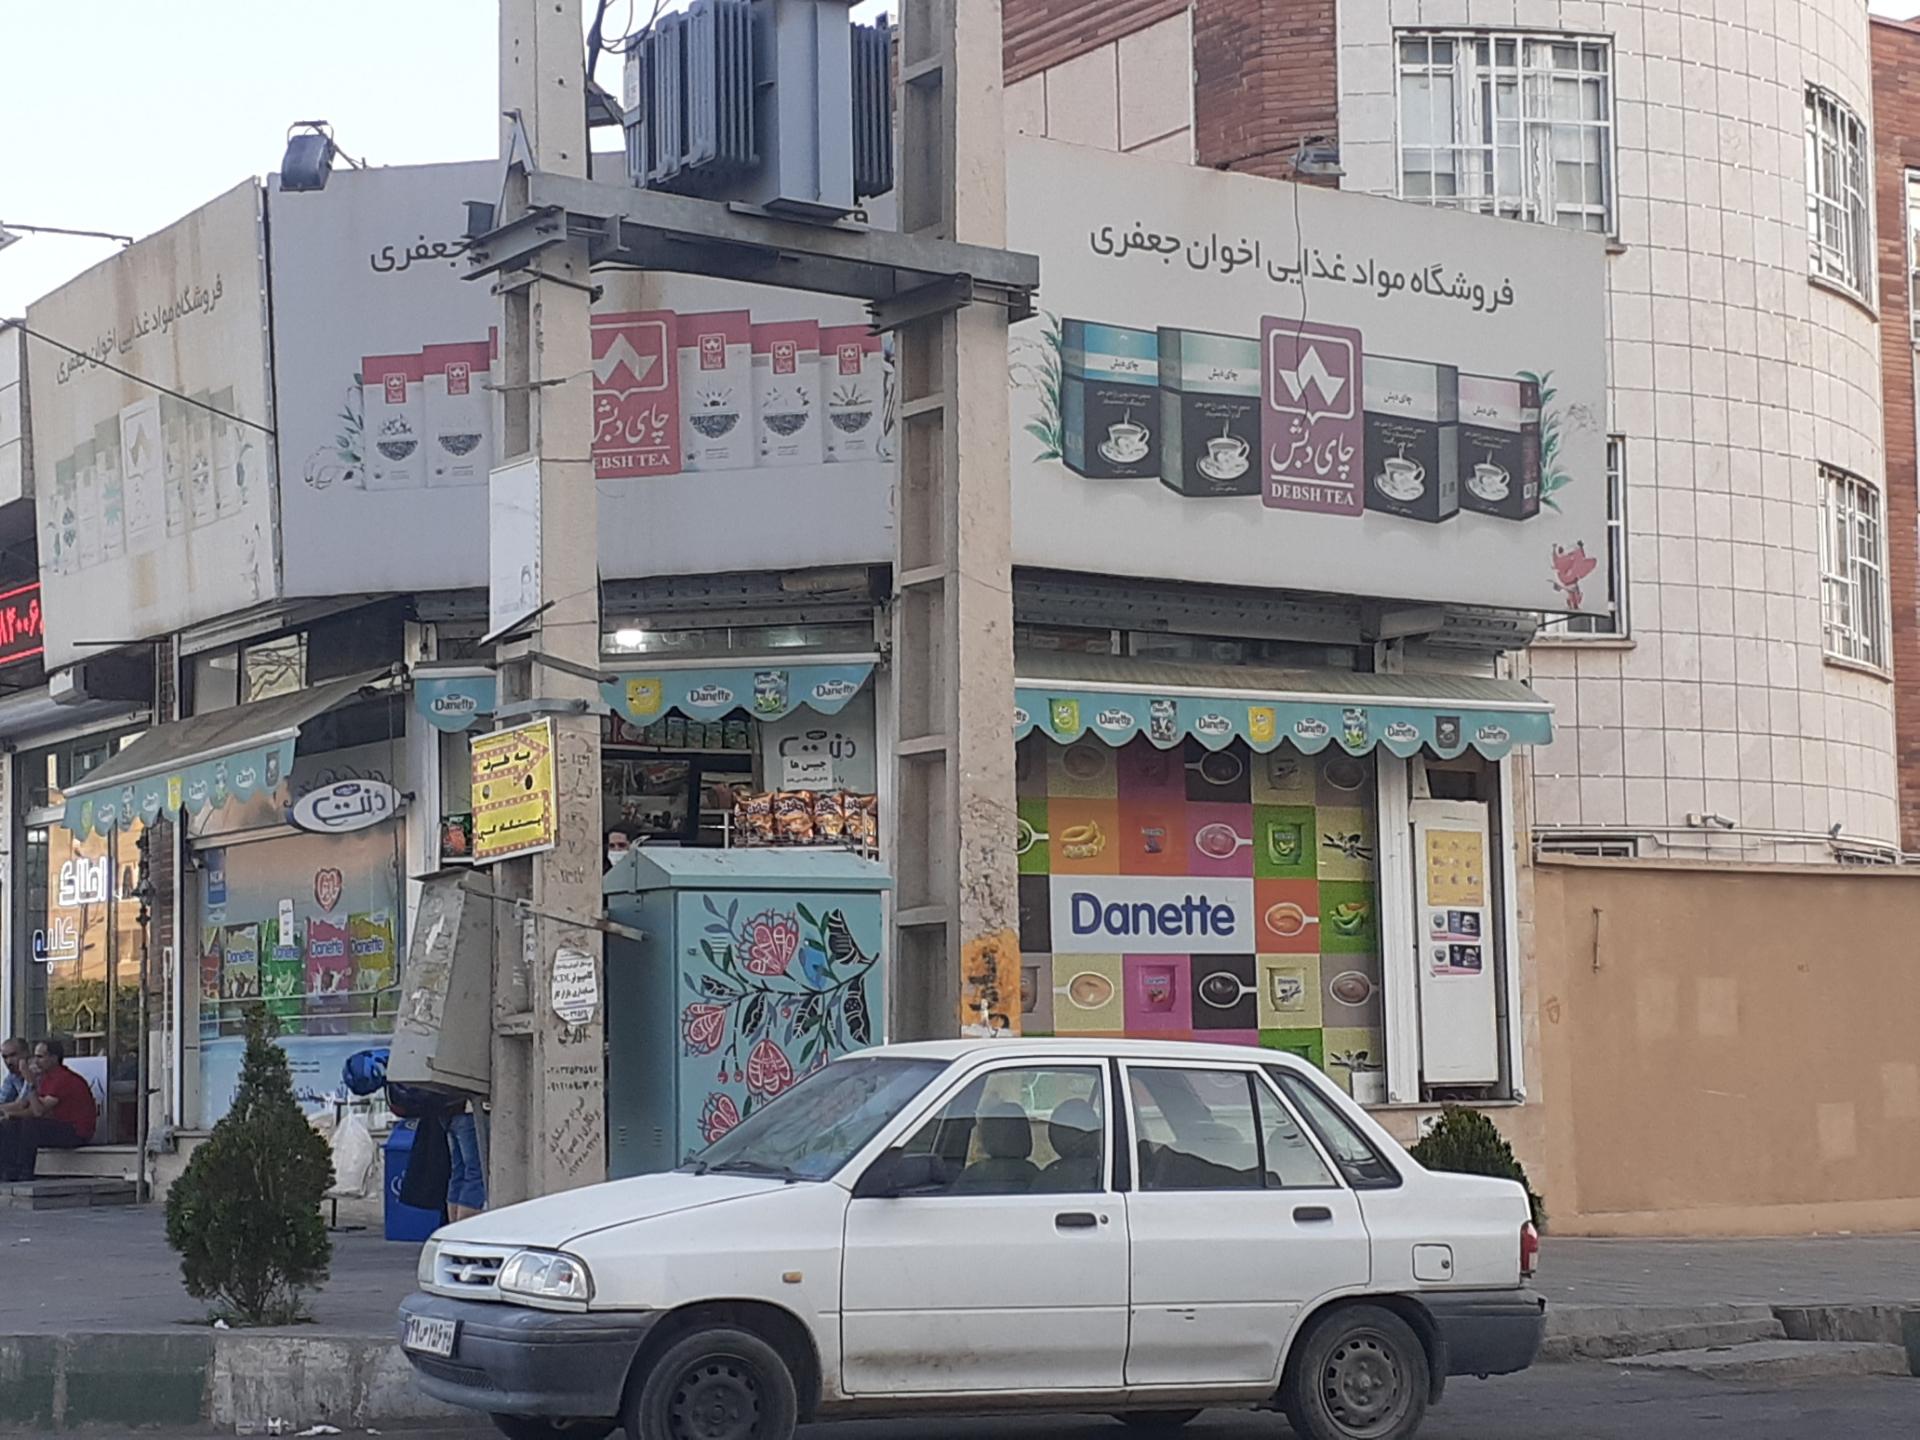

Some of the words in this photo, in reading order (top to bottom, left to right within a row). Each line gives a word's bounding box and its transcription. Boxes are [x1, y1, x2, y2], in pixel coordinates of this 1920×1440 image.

[1090, 221, 1181, 265] جعفری
[1186, 232, 1260, 274] اخوان
[1267, 248, 1346, 285] غذایی
[1352, 258, 1405, 298] مواد
[176, 273, 223, 316] فروشگاه
[1410, 262, 1514, 313] فروشگاه
[152, 304, 174, 334] مواد
[625, 403, 669, 444] چای
[1270, 418, 1313, 472] دبش
[1314, 432, 1355, 480] چای
[636, 453, 671, 467] TEA
[1271, 483, 1321, 502] DEBSH
[1324, 488, 1355, 505] TEA
[434, 699, 475, 711] Danette
[690, 690, 732, 703] Danette
[1099, 713, 1132, 727] Danette
[1198, 718, 1230, 731] Danette
[1296, 723, 1328, 736] Danette
[1387, 726, 1417, 739] Danette
[1478, 728, 1508, 741] Danette
[1070, 892, 1236, 937] Danette
[226, 951, 255, 964] Danette
[310, 939, 344, 956] Danette
